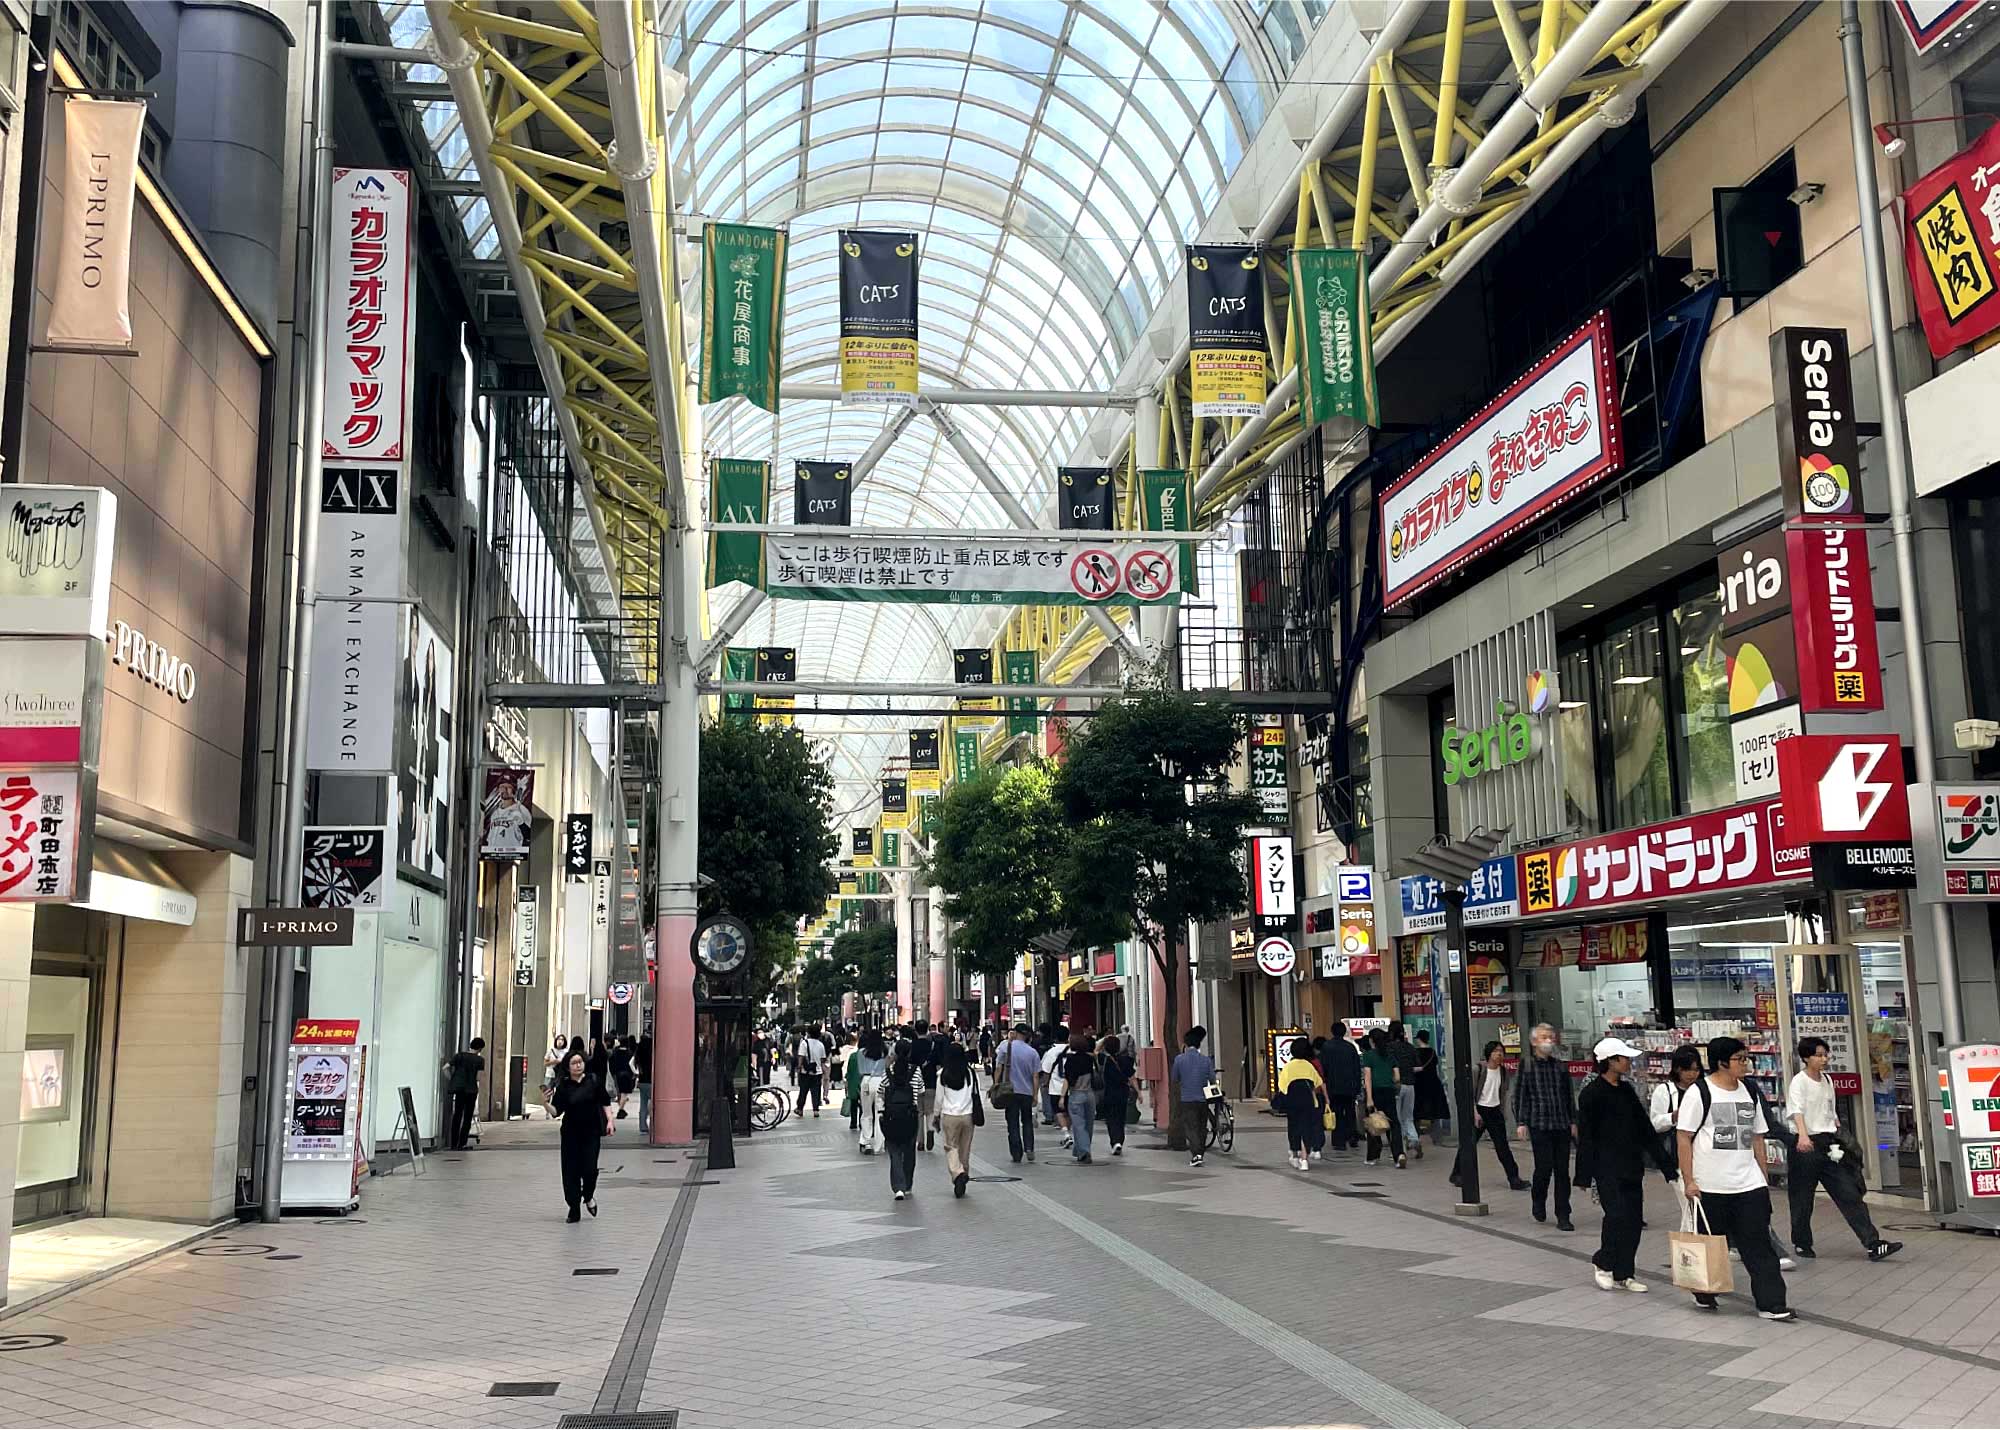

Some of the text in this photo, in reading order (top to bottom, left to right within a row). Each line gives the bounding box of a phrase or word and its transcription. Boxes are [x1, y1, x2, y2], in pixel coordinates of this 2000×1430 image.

[82, 152, 111, 290] I-PRIMO
[1927, 204, 1982, 305] 焼肉
[860, 284, 900, 304] CATS
[1209, 296, 1247, 316] CATS
[344, 206, 387, 450] カラオケマック
[732, 279, 753, 367] 花屋商事
[1196, 353, 1263, 363] 12年ぶりに仙台へ
[1801, 338, 1842, 448] Seria
[1400, 381, 1593, 558] カラオケ まねきねこ
[1812, 481, 1834, 498] 100
[808, 499, 838, 514] CATS
[1073, 504, 1100, 519] CATS
[778, 545, 1068, 567] ここは歩行喫煙防止重点区域です
[778, 565, 954, 586] 歩行喫煙は禁止です
[63, 582, 79, 591] 3F
[1823, 521, 1858, 670] サンドラッグ
[340, 530, 366, 761] ARMANI EXCHANGE
[964, 673, 983, 684] CATS
[1837, 675, 1862, 699] 薬
[916, 748, 932, 758] CATS
[1298, 733, 1329, 768] カラオケ
[1441, 700, 1531, 786] Seria
[1252, 747, 1285, 766] ネット
[1253, 767, 1286, 785] カフェ
[0, 775, 39, 895] ラーメン
[313, 834, 374, 856] ダーツ
[572, 819, 588, 868] むかでや
[35, 816, 64, 895] 町田商店
[1583, 811, 1758, 900] サンドラッグ
[1846, 847, 1913, 865] BELLEMODE
[1268, 844, 1286, 909] スシロー
[1527, 858, 1550, 906] 薬
[1947, 876, 1967, 889] たばこ
[1970, 875, 1985, 889] 酒
[1411, 863, 1503, 911] 処方受付
[362, 891, 377, 904] 2F
[1264, 917, 1287, 926] B1F
[1341, 908, 1373, 920] Seria
[262, 921, 338, 933] I-PRIMO
[520, 905, 533, 958] Cat cafe
[1260, 951, 1293, 961] スシロー
[1469, 940, 1505, 952] Seria
[1323, 953, 1348, 971] スシロー
[1402, 943, 1416, 976] 薬
[1471, 977, 1490, 995] 薬
[1403, 991, 1432, 1007] サンドラッグ
[1471, 1004, 1511, 1014] サンドラッグ
[300, 1072, 345, 1085] カラオケ
[304, 1084, 337, 1096] マック
[296, 1105, 343, 1117] ダーツバー
[1969, 1147, 1993, 1170] 酒
